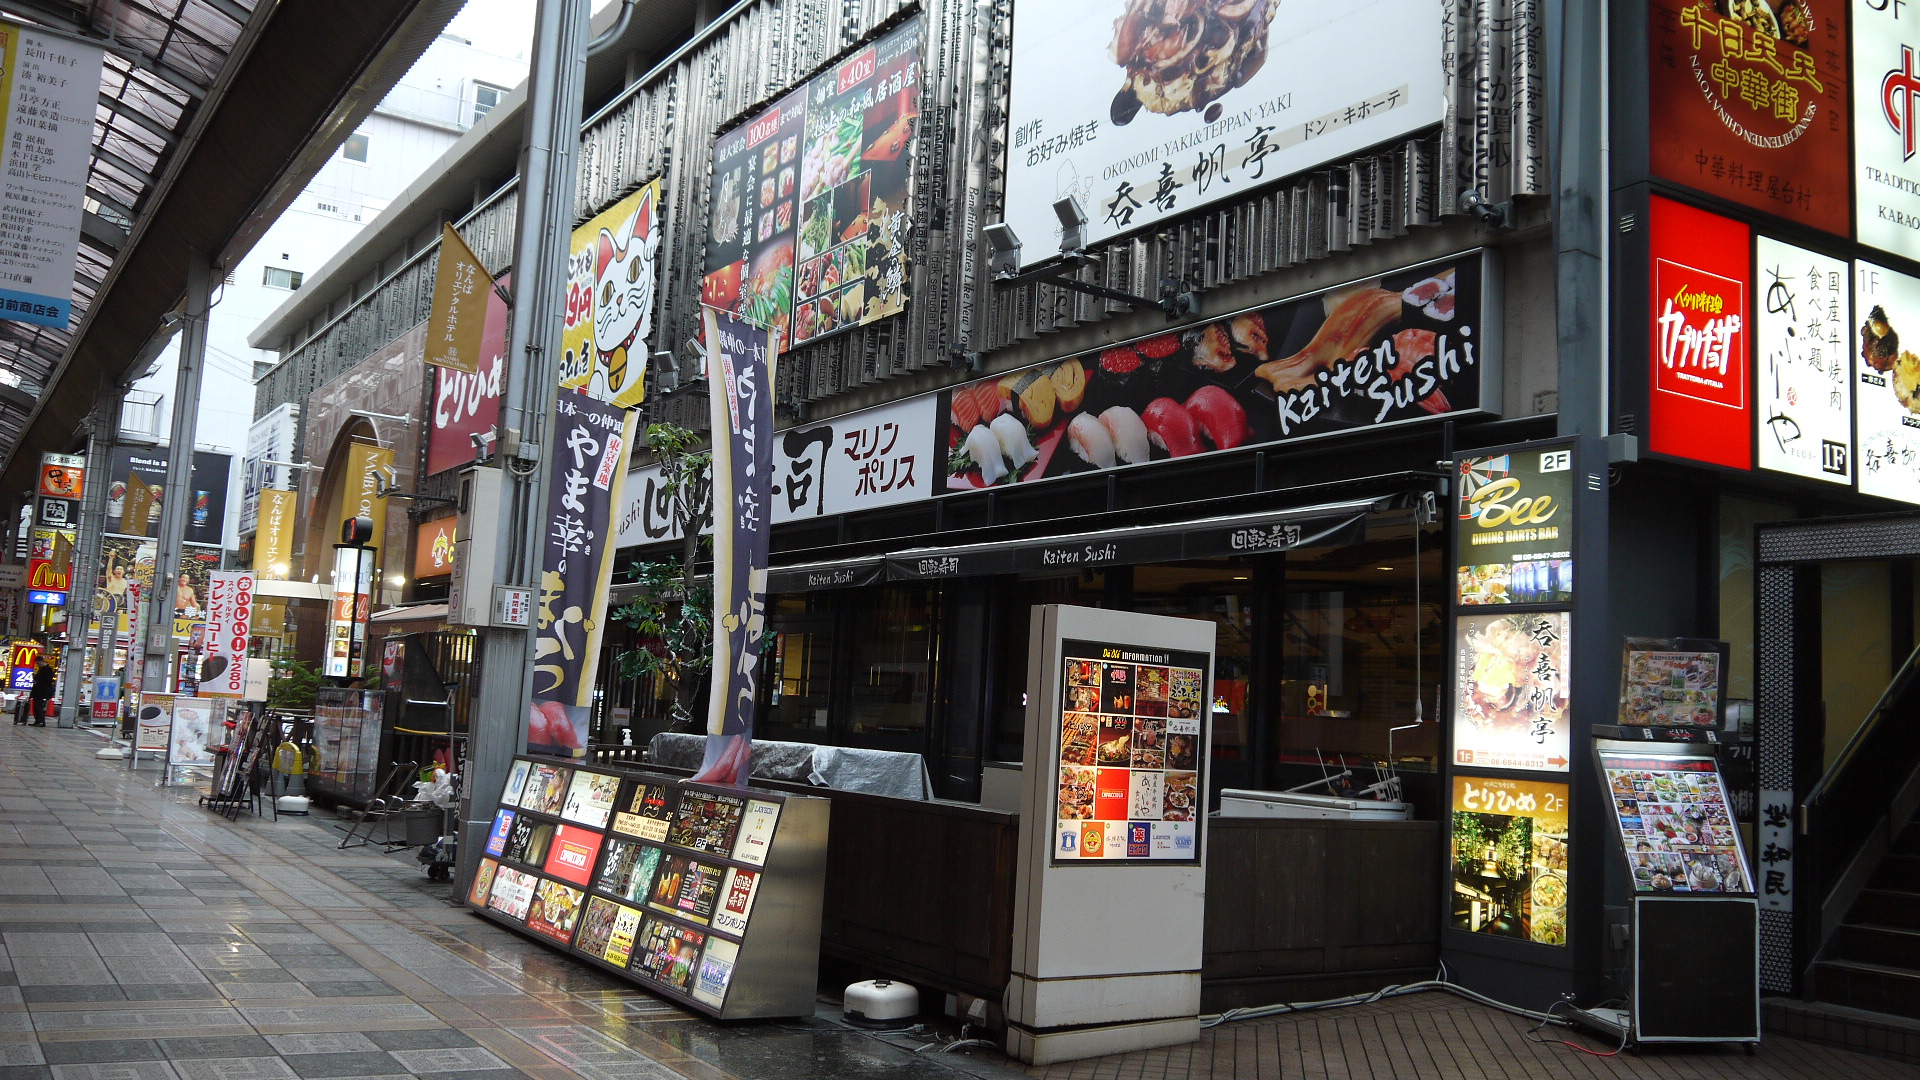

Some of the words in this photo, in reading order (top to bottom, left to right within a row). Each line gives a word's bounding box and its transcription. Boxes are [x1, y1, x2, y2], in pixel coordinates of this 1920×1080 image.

[814, 62, 919, 139] 極上の和風居酒屋
[1526, 73, 1543, 110] Like
[1711, 58, 1799, 123] 中華街
[1014, 118, 1044, 149] 創作
[1302, 87, 1403, 142] ドン・キホーテ
[1526, 113, 1543, 149] New
[1026, 119, 1100, 168] お好み焼き
[1103, 124, 1281, 230] 呑喜帆亭
[1526, 155, 1542, 193] York
[1694, 148, 1813, 211] 中華料理屋台村
[463, 265, 475, 295] なんば
[1860, 269, 1880, 294] 1F
[445, 261, 465, 343] オリエンタルホテル
[1807, 264, 1825, 373] 食べ放題
[1828, 270, 1844, 412] 国産牛焼肉
[1278, 339, 1399, 437] Kaiten
[1369, 324, 1475, 424] Sushi
[845, 422, 901, 463] マリン
[1544, 453, 1568, 471] 2F
[1823, 442, 1847, 472] 1F
[361, 451, 379, 495] NAMBA
[856, 453, 916, 497] ポリス
[618, 499, 642, 541] ushi
[1470, 477, 1560, 528] Bee
[1043, 547, 1081, 565] Kaiten
[1085, 544, 1117, 563] Sushi
[1231, 524, 1302, 551] 回転寿司
[1472, 530, 1504, 546] DINING
[1505, 528, 1537, 544] DARTS
[1537, 526, 1559, 541] BAR
[808, 572, 832, 588] Kaiten
[918, 556, 961, 577] 回転寿司
[207, 579, 227, 663] ブレンドコーヒー
[1530, 620, 1560, 745] 呑喜帆亭
[1463, 782, 1537, 813] とりひめ
[1545, 793, 1564, 813] 2F
